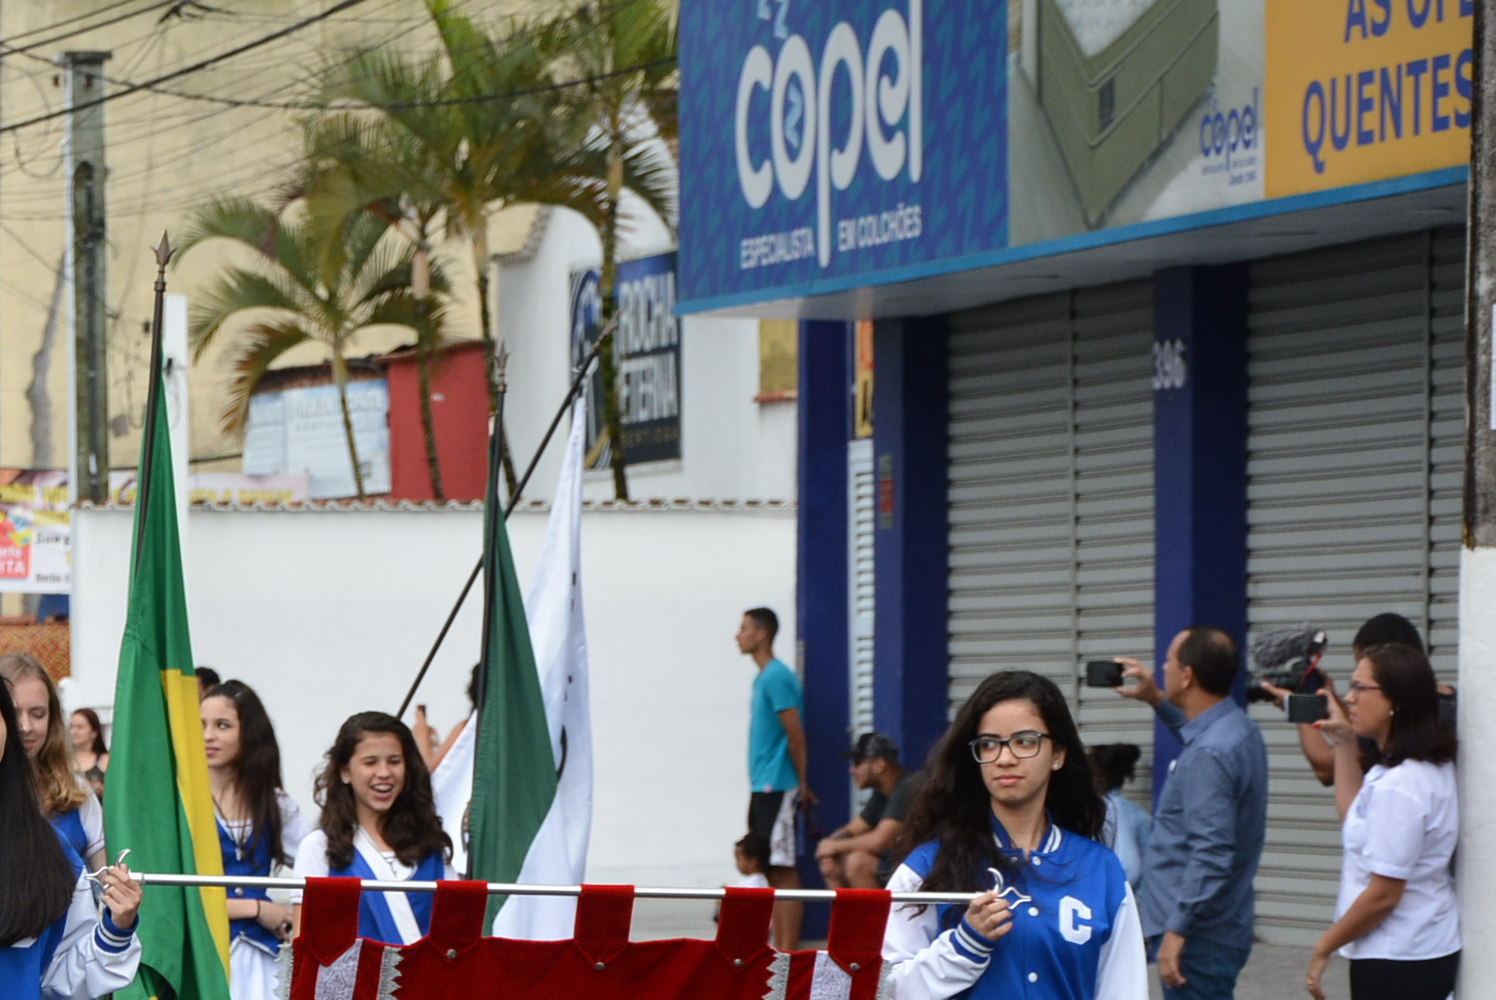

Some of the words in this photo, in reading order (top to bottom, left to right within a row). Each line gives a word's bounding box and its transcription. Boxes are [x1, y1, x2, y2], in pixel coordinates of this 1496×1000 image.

[1344, 0, 1392, 43] AS
[735, 0, 923, 269] copel
[1302, 48, 1473, 175] QUENTES
[1059, 895, 1092, 945] C
